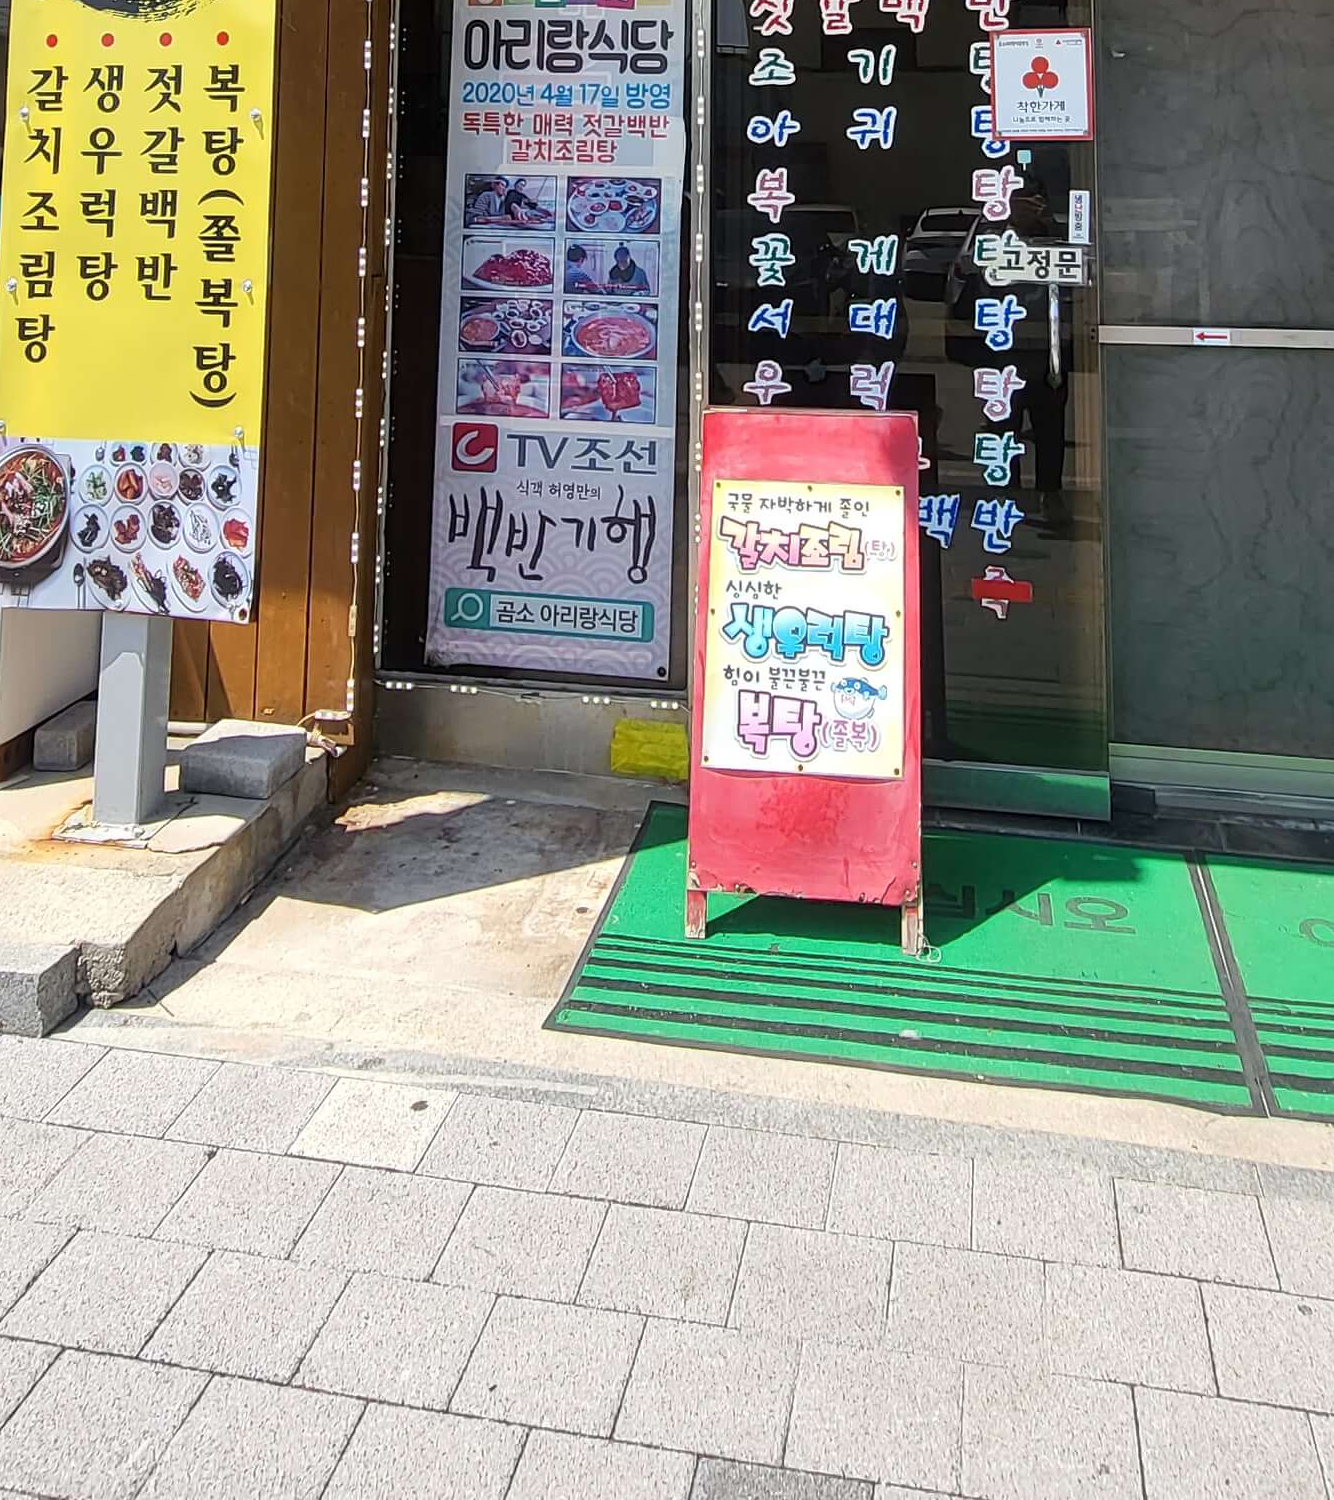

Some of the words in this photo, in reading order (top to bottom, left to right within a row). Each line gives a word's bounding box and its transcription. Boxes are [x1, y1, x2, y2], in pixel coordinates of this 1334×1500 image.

[464, 19, 674, 74] 아리랑식당
[462, 82, 535, 106] 2020년
[540, 83, 573, 107] 4월
[579, 84, 619, 108] 17일
[626, 83, 671, 109] 방영
[1017, 100, 1066, 113] 착한가게
[463, 111, 523, 135] 독특한
[533, 112, 574, 137] 매력
[583, 114, 669, 139] 젓갈백반
[511, 139, 617, 163] 갈치조림탕
[76, 65, 124, 301] 생우럭탕
[136, 64, 185, 301] 젓갈백반
[15, 65, 69, 364] 갈치조림탕
[506, 434, 657, 475] TV조선
[516, 479, 543, 498] 식객
[548, 482, 601, 501] 허영만의
[728, 493, 752, 513] 국물
[759, 496, 832, 514] 자박하게
[839, 497, 870, 518] 졸인
[448, 484, 656, 584] 백반기행
[496, 600, 535, 623] 곰소
[540, 604, 638, 632] 아리랑식당
[722, 603, 889, 667] 생우럭탕
[723, 665, 760, 686] 힘이
[768, 666, 826, 691] 불끈불끈
[737, 689, 822, 759] 복탕
